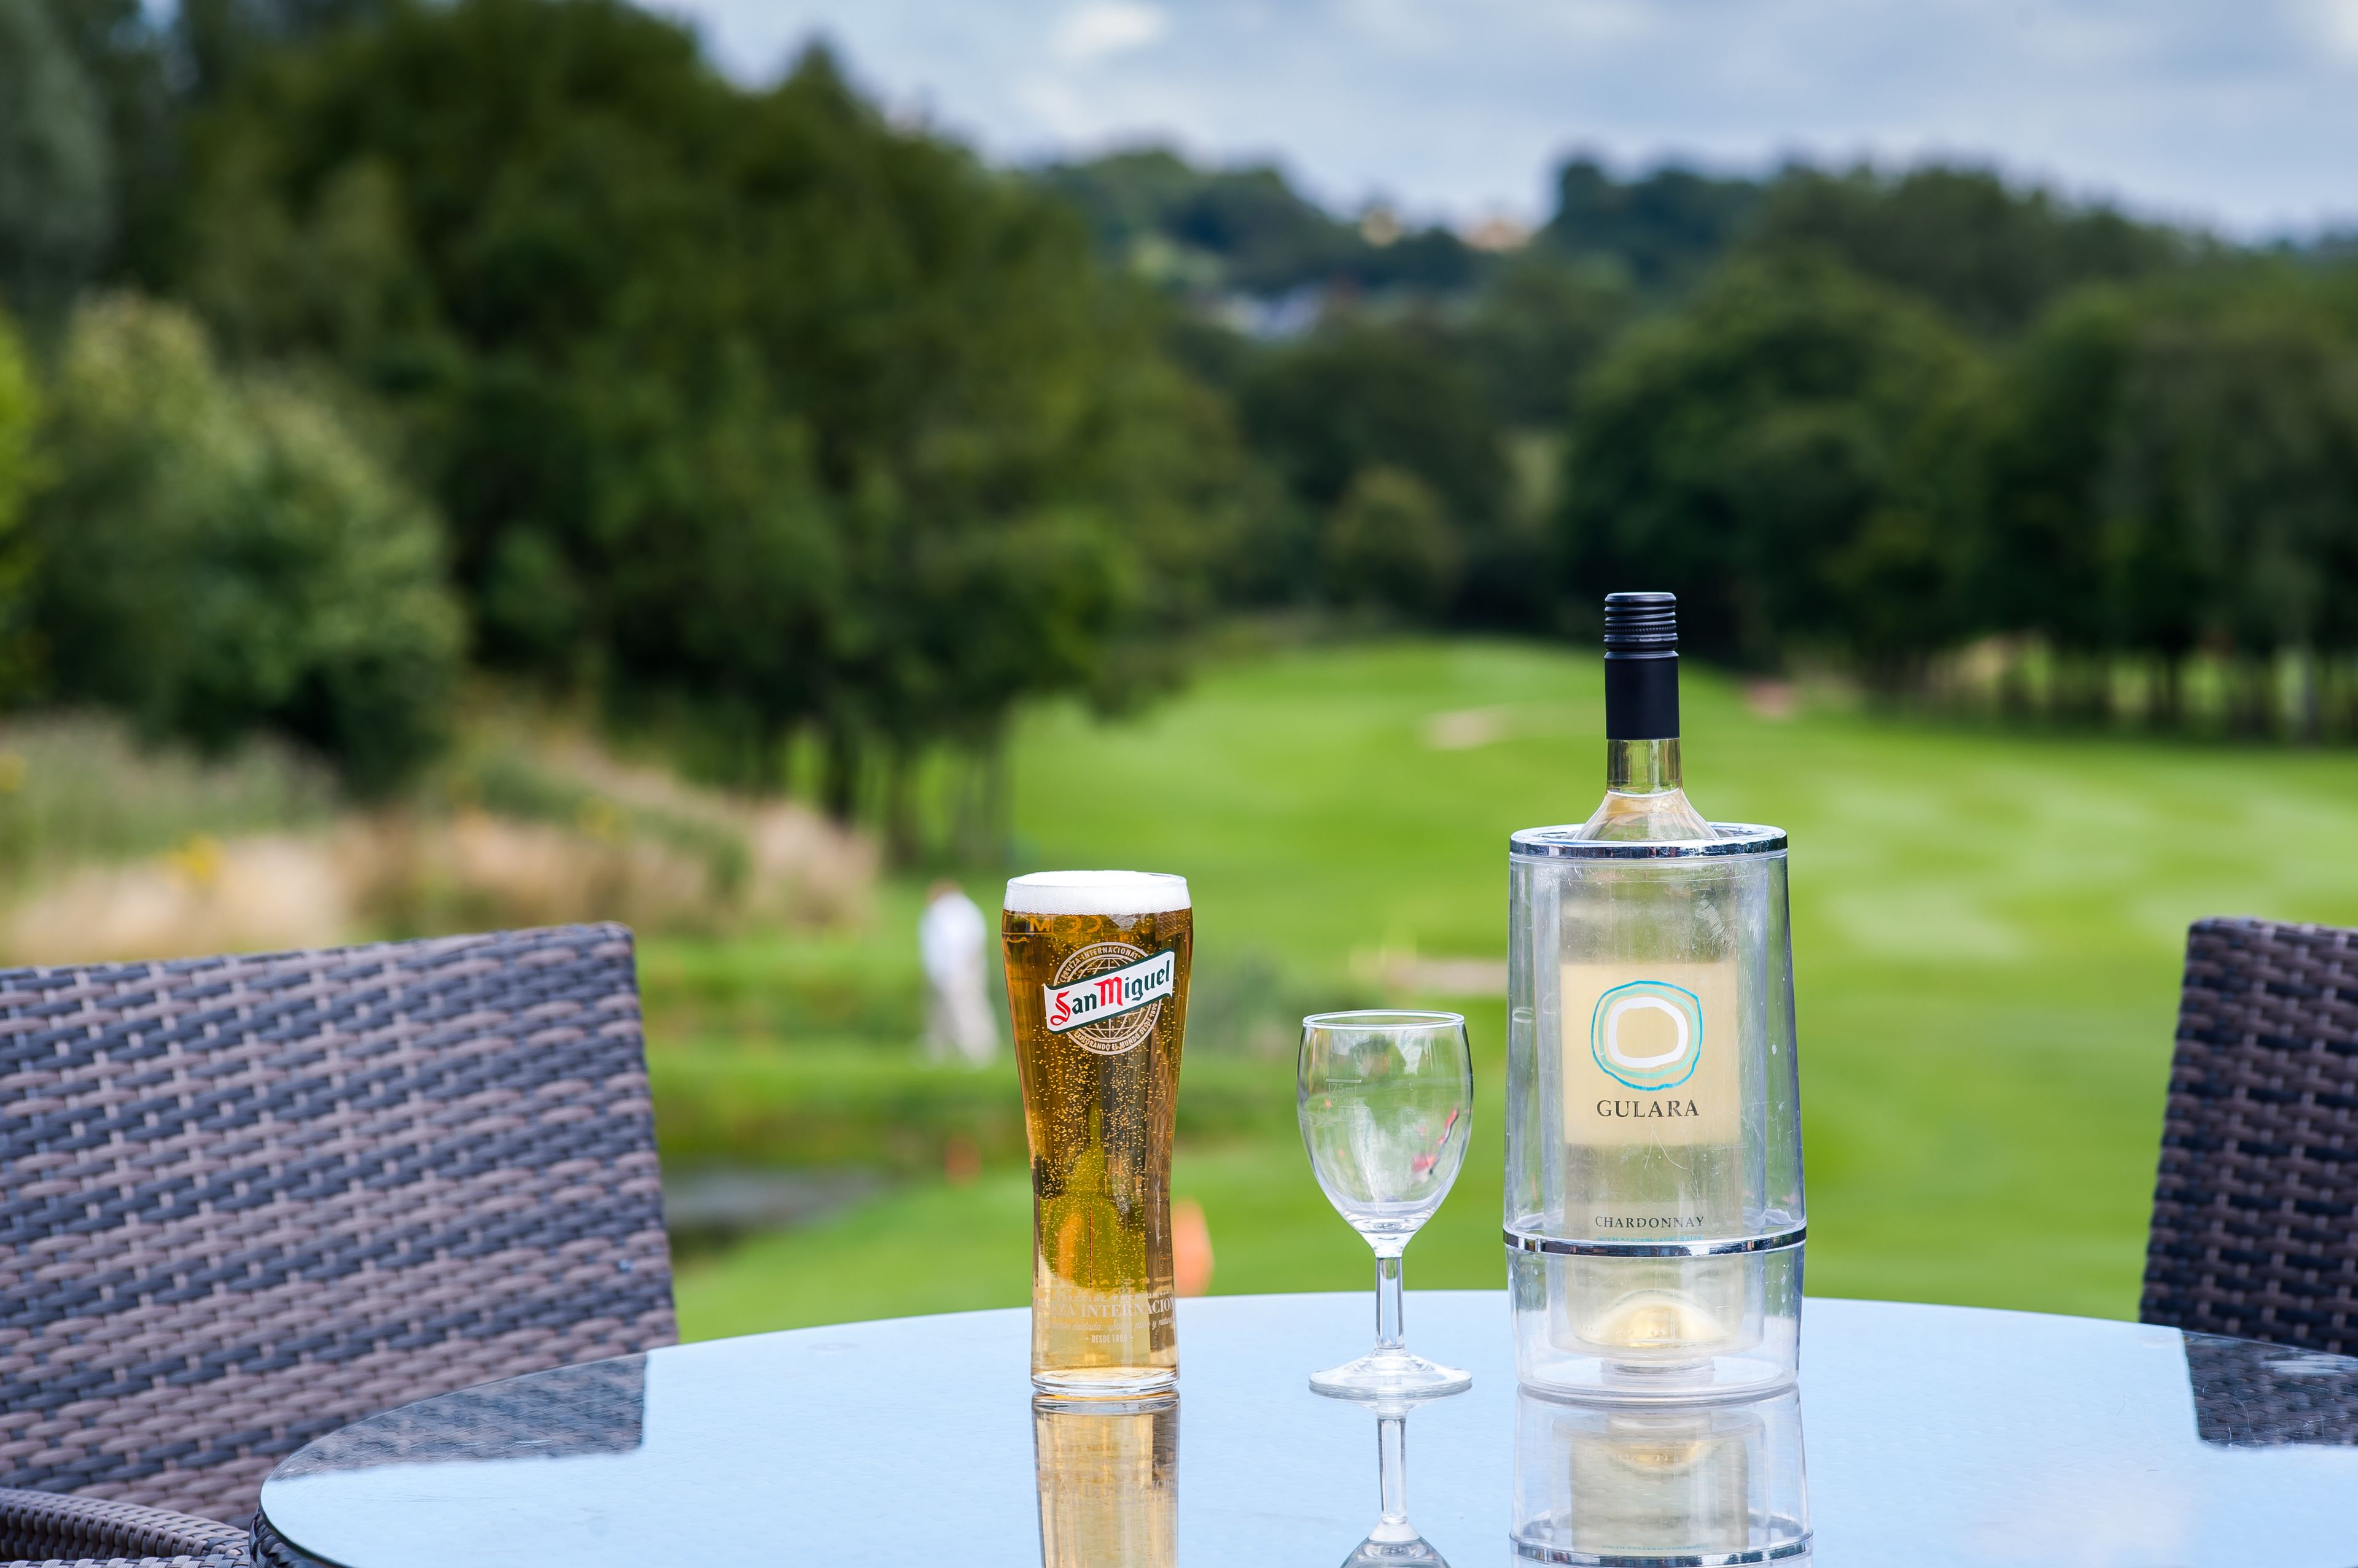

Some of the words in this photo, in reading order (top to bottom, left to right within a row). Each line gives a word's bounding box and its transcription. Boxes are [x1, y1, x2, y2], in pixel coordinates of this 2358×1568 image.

[1059, 958, 1081, 983] CERVEZA
[1081, 946, 1138, 960] INTERNACIONAL
[1050, 990, 1097, 1026] San
[1094, 960, 1170, 1007] Miguel
[1074, 1031, 1110, 1050] EXPLORANDO
[1119, 1033, 1140, 1049] MUNDO
[1139, 1016, 1153, 1034] DESDE
[1597, 1100, 1700, 1117] GULARA
[1595, 1216, 1704, 1228] CHARDONNAY
[1113, 1292, 1158, 1301] PREMUM
[1091, 1334, 1111, 1343] DESDE
